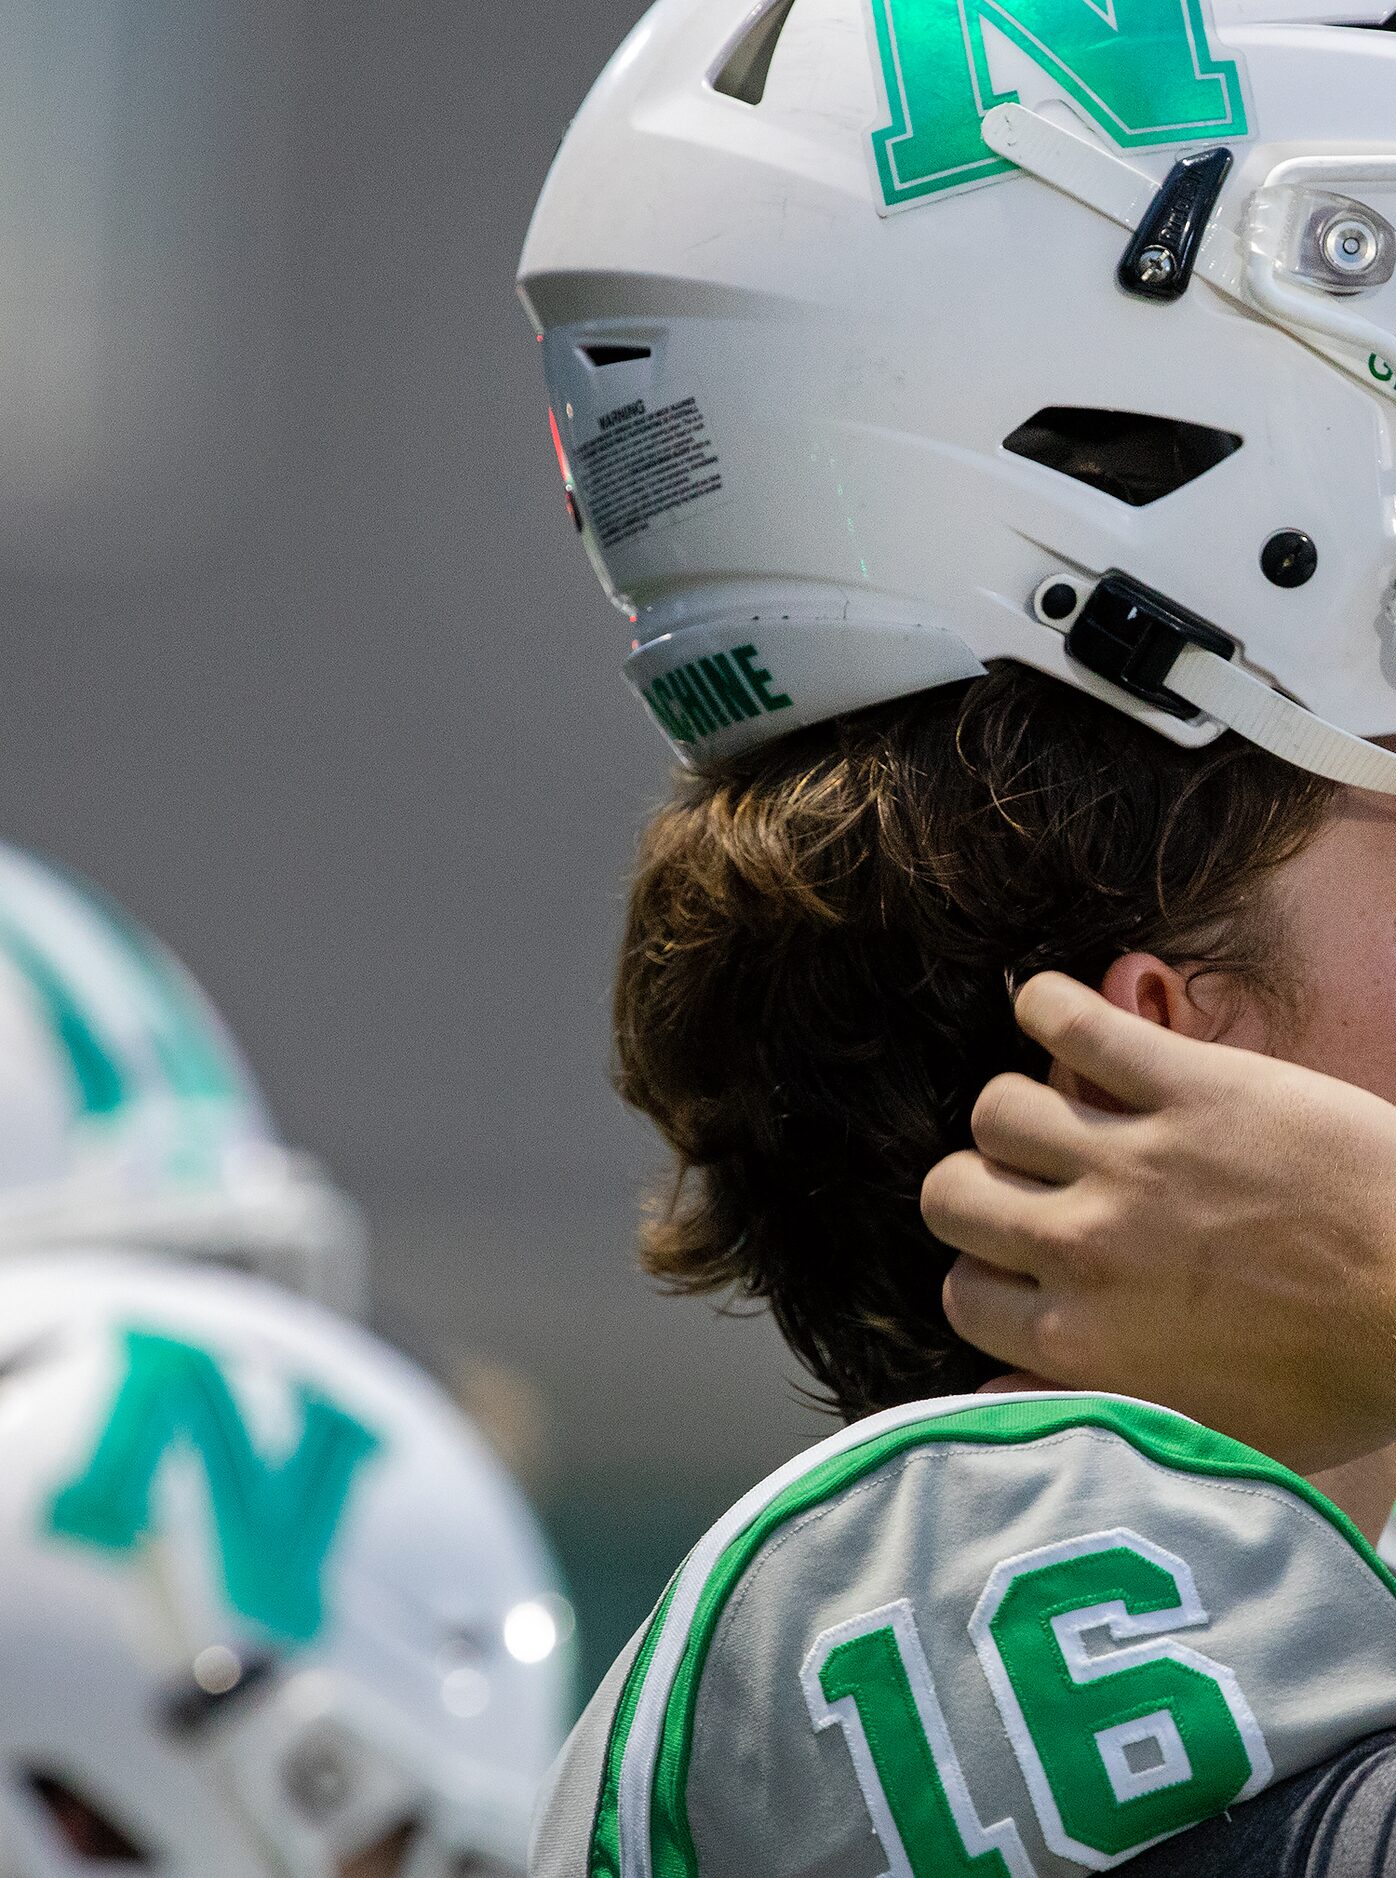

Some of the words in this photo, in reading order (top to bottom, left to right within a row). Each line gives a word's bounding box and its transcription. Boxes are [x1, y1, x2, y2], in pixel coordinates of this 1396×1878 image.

[871, 0, 1249, 207] N
[641, 643, 794, 746] CHINE
[40, 1326, 384, 1647] N
[799, 1526, 1274, 1878] 16
